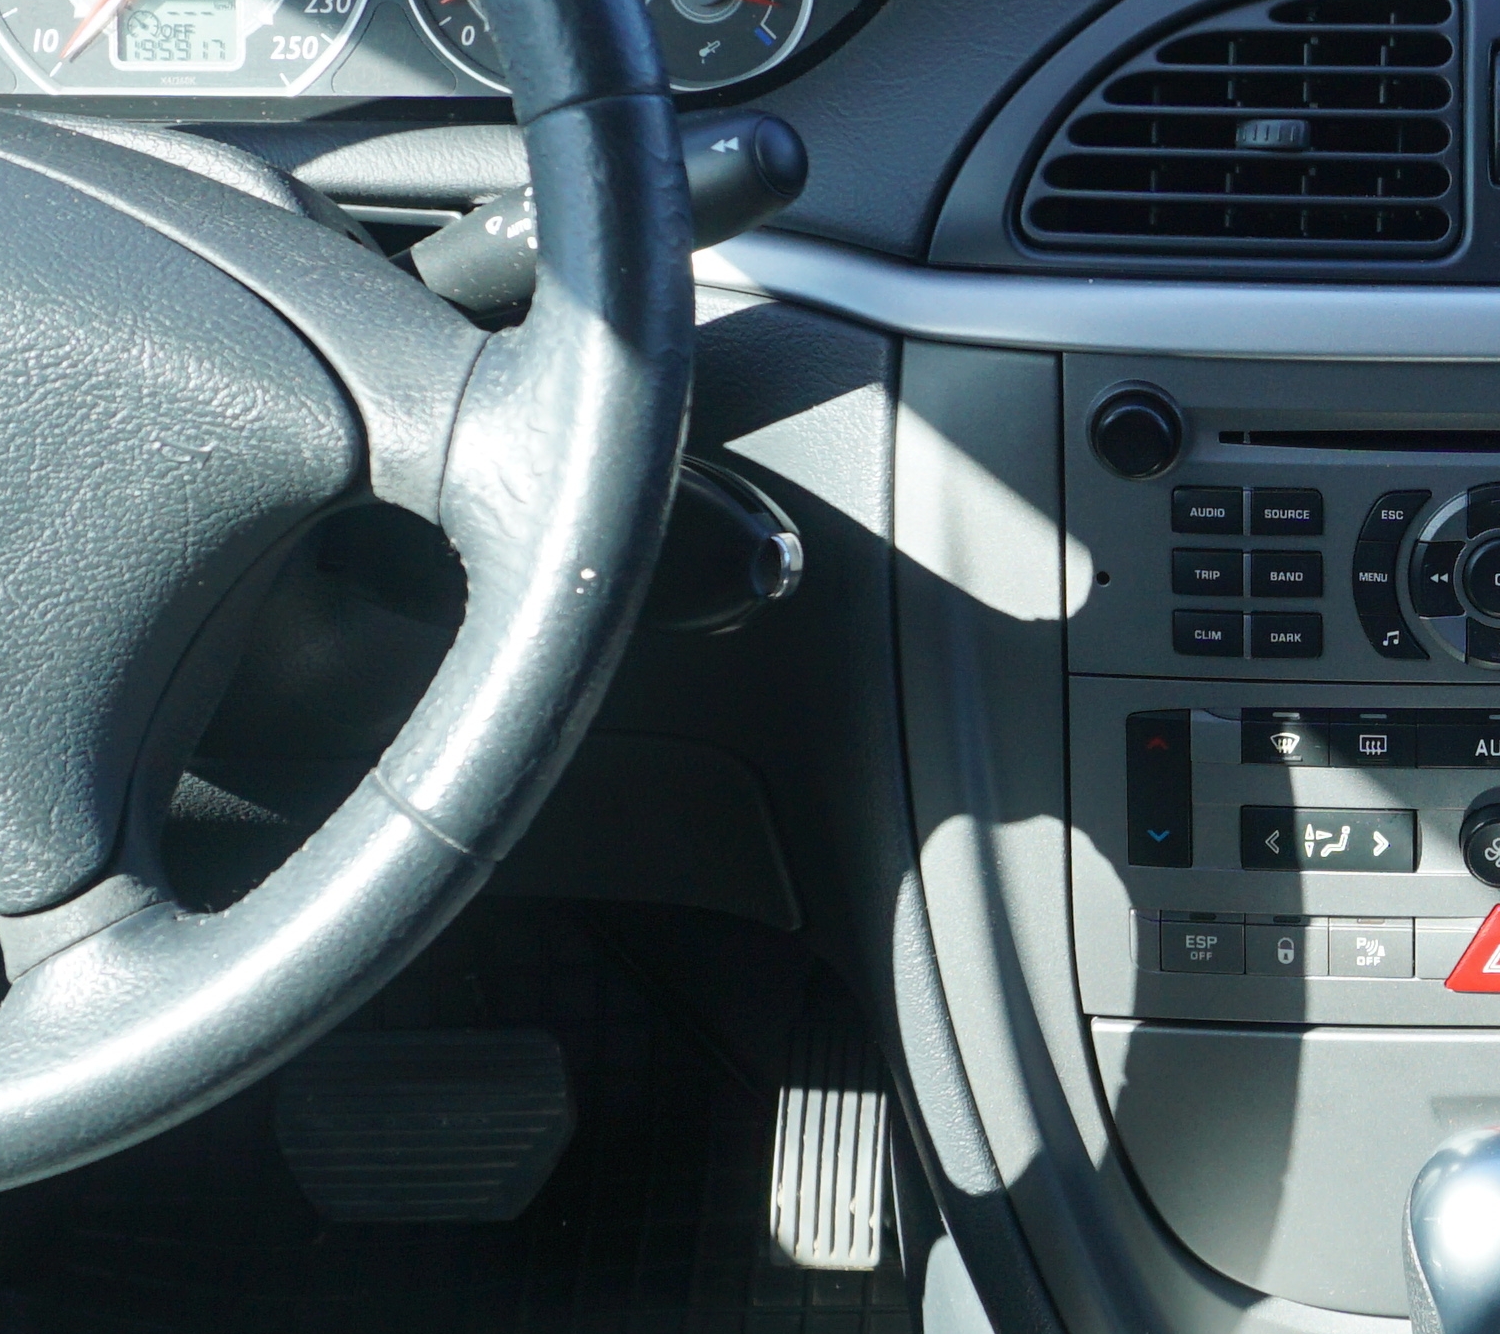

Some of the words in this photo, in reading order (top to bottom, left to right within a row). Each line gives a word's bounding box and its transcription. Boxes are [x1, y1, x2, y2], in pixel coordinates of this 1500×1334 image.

[161, 23, 196, 41] OFF
[461, 25, 475, 47] 0
[33, 28, 59, 53] 10
[270, 36, 319, 61] 250
[1190, 507, 1226, 519] AUDIO
[1264, 508, 1310, 520] SOURCE
[1381, 509, 1404, 520] ESC
[1194, 569, 1221, 581] TRIP
[1270, 570, 1304, 582] BAND
[1359, 571, 1388, 584] MENU
[1194, 629, 1222, 641] CLIM
[1270, 632, 1302, 644] DARK
[1185, 934, 1218, 950] ESP
[1190, 951, 1213, 961] OFF
[1356, 955, 1382, 967] OFF
